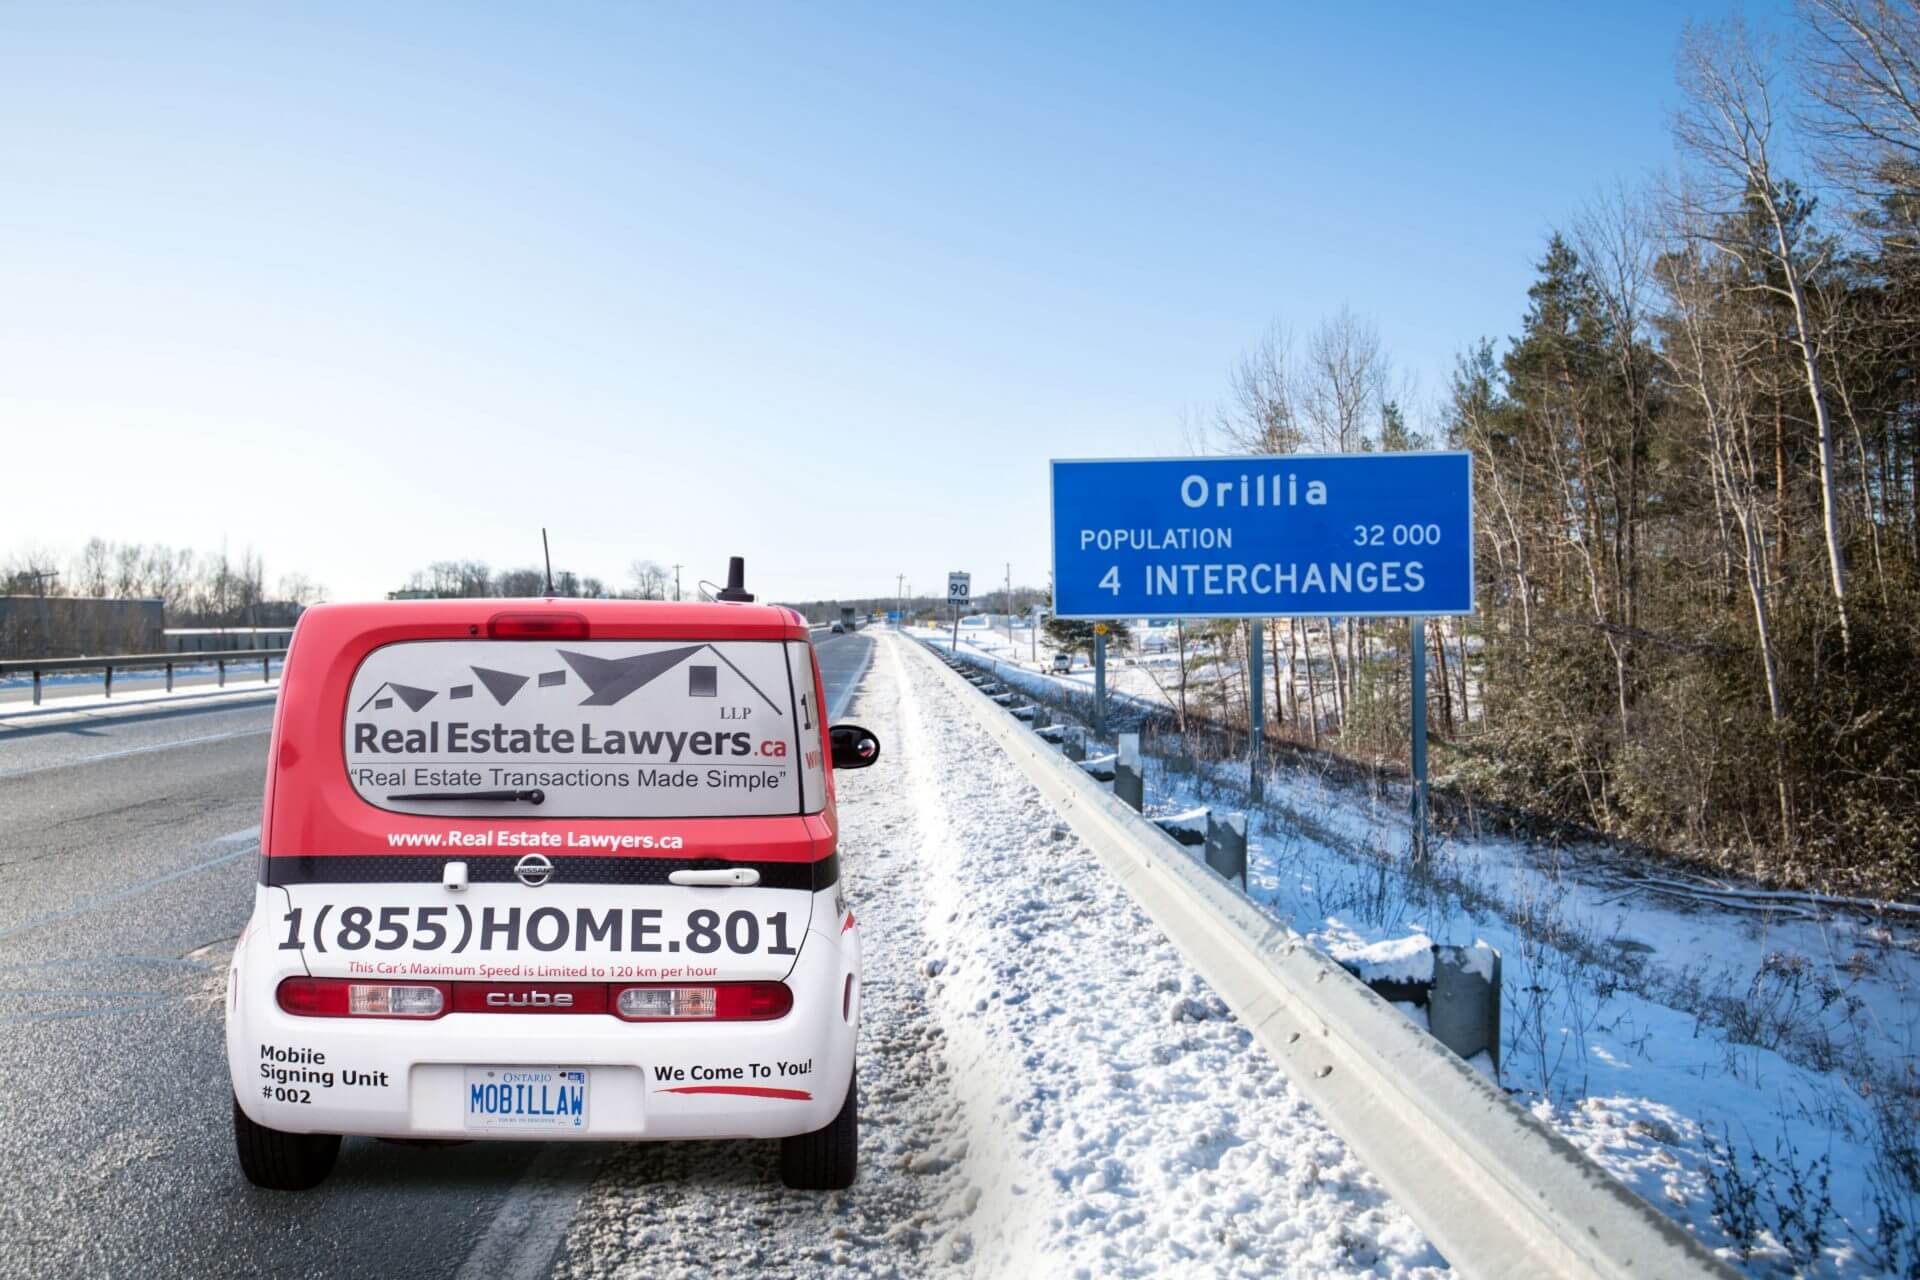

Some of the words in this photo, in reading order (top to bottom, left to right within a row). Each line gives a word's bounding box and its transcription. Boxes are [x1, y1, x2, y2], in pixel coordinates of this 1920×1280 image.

[1180, 473, 1328, 507] Orillia
[1080, 528, 1233, 550] POPULATION
[1353, 525, 1385, 546] 32
[1392, 524, 1441, 545] 000
[1098, 566, 1121, 595] 4
[1145, 562, 1426, 595] INTERCHANGES
[950, 583, 968, 596] 90
[719, 706, 752, 719] LLP
[414, 768, 482, 786] Estate
[489, 768, 630, 787] Transactions
[637, 769, 699, 787] Made
[567, 831, 683, 851] Lawyers.ca
[278, 904, 797, 955] 1(855)HOME.801
[349, 961, 374, 973] This
[377, 962, 407, 974] Car's
[410, 963, 475, 976] Maximum
[479, 964, 520, 978] Speed
[524, 965, 535, 976] is
[538, 966, 588, 977] Limited
[592, 966, 605, 977] to
[610, 966, 633, 977] 120
[637, 965, 657, 977] km
[661, 966, 683, 979] per
[686, 965, 718, 976] hour
[486, 990, 574, 1006] cube
[260, 1063, 335, 1088] Signing
[342, 1070, 389, 1087] Unit
[654, 1066, 685, 1081] We
[690, 1065, 744, 1080] Come
[749, 1063, 772, 1078] To
[777, 1059, 813, 1076] You!
[262, 1085, 312, 1104] #002
[470, 1083, 584, 1115] MOBILLAW
